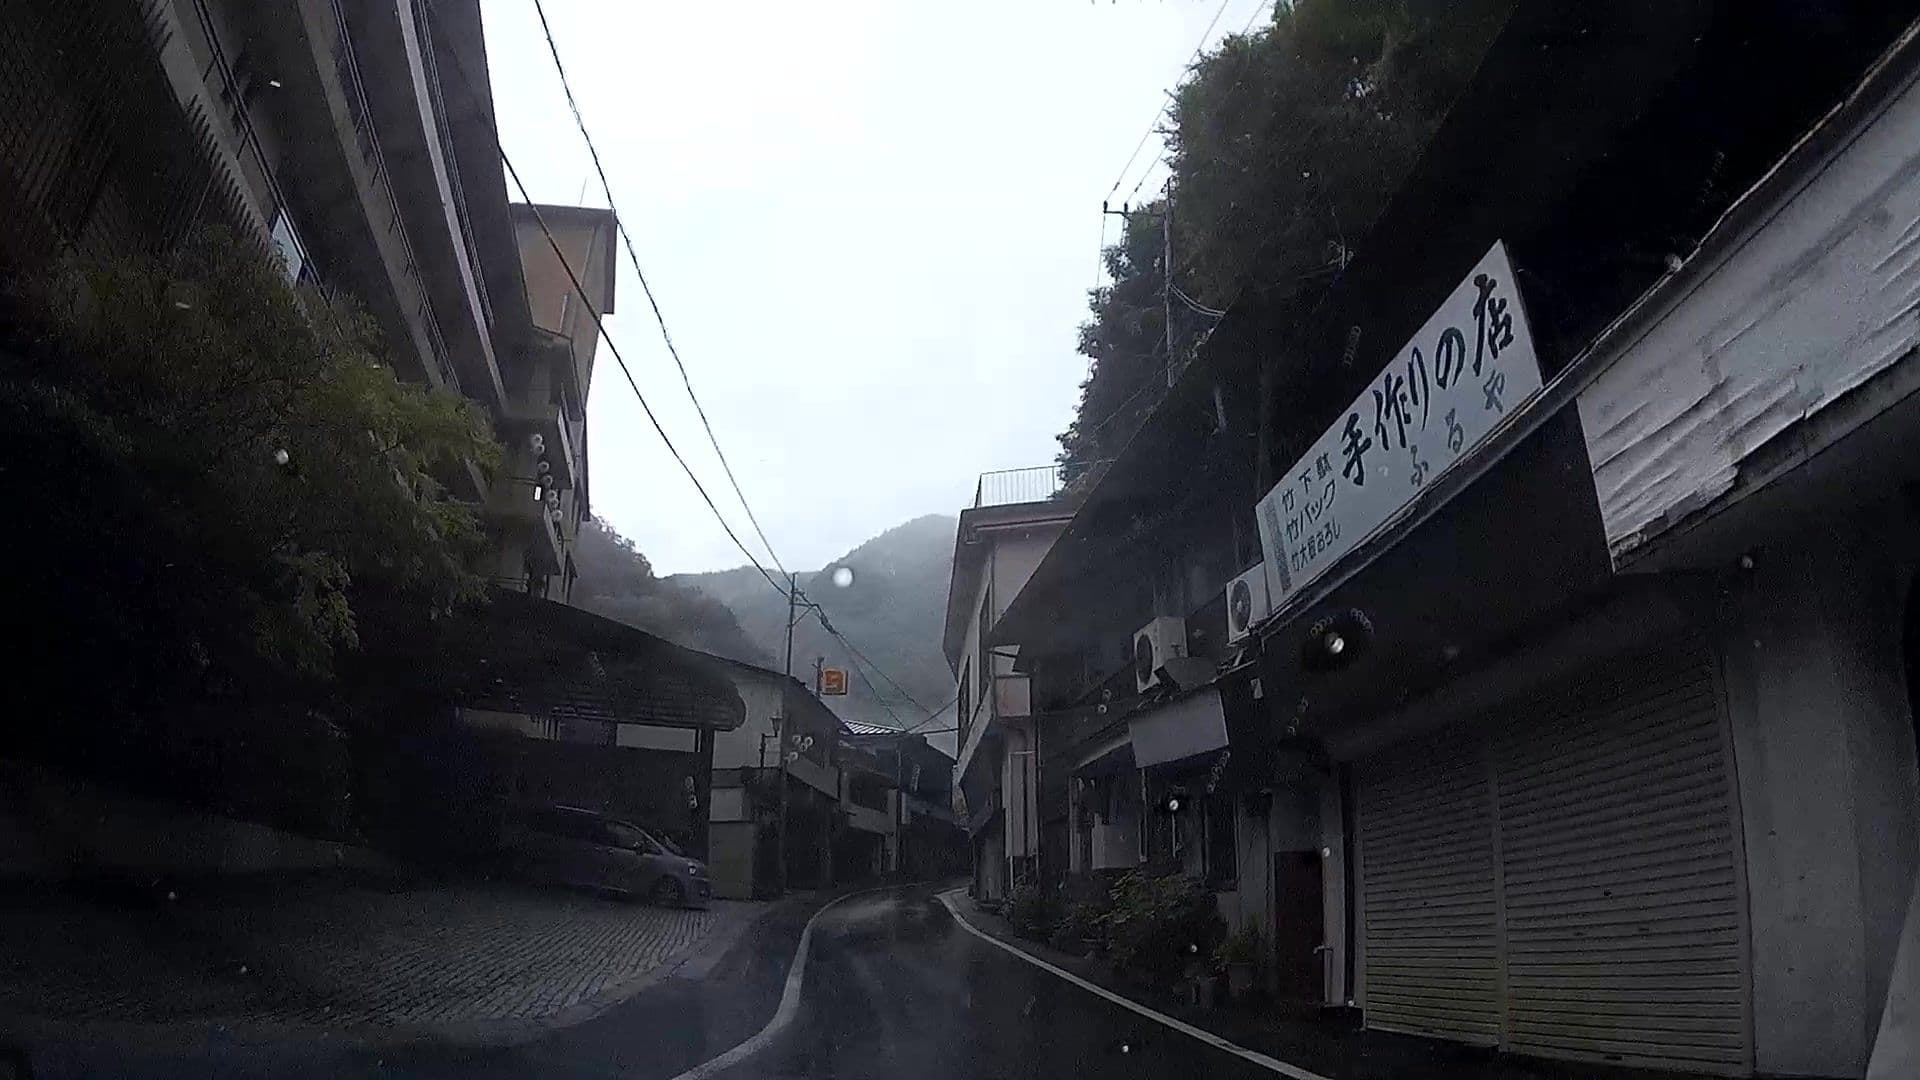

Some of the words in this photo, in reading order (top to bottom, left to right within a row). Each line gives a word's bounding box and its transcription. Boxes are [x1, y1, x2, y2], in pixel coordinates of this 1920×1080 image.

[1341, 273, 1514, 486] 手作りの店
[1411, 369, 1506, 487] ふるや
